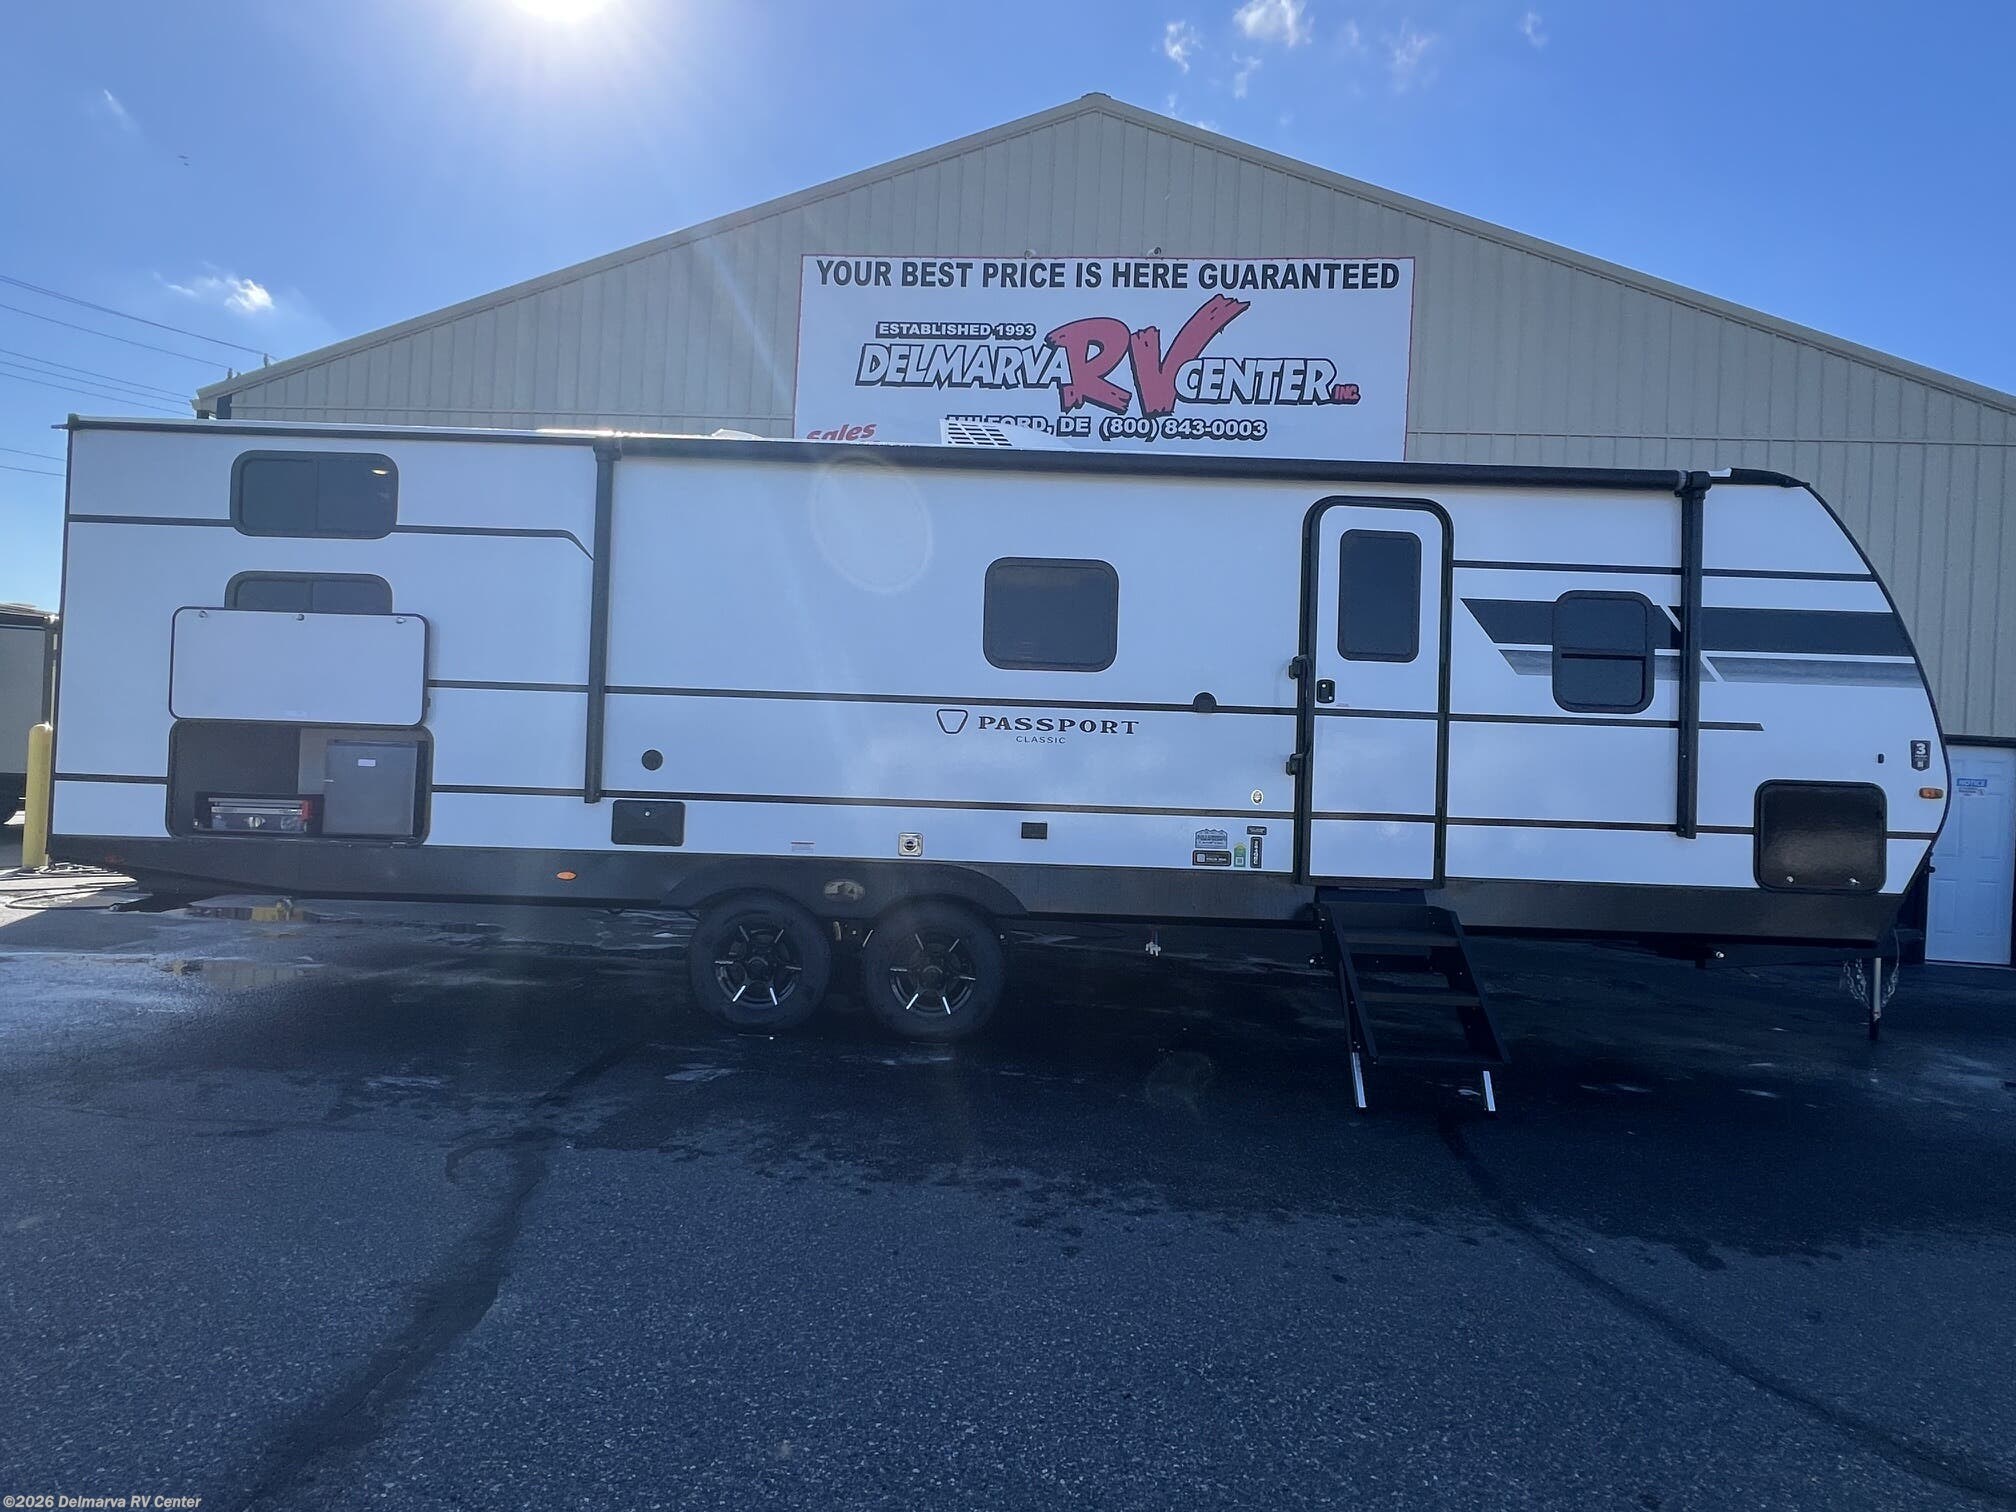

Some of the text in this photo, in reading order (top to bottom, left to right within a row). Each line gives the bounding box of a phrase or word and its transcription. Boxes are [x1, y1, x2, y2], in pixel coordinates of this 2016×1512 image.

[816, 260, 1399, 290] YOUR BEST PRICE IS HERE GUARANTEED
[877, 322, 1036, 339] ESTABLISHED 1993
[855, 344, 1073, 390] DELMARVA
[1045, 294, 1250, 416] RV
[1174, 357, 1338, 405] CENTER
[946, 415, 1267, 441] ORD, DE (800) 843-0003
[978, 716, 1139, 735] PASSPORT
[1016, 735, 1066, 744] CLASSIC
[1916, 743, 1926, 755] 3
